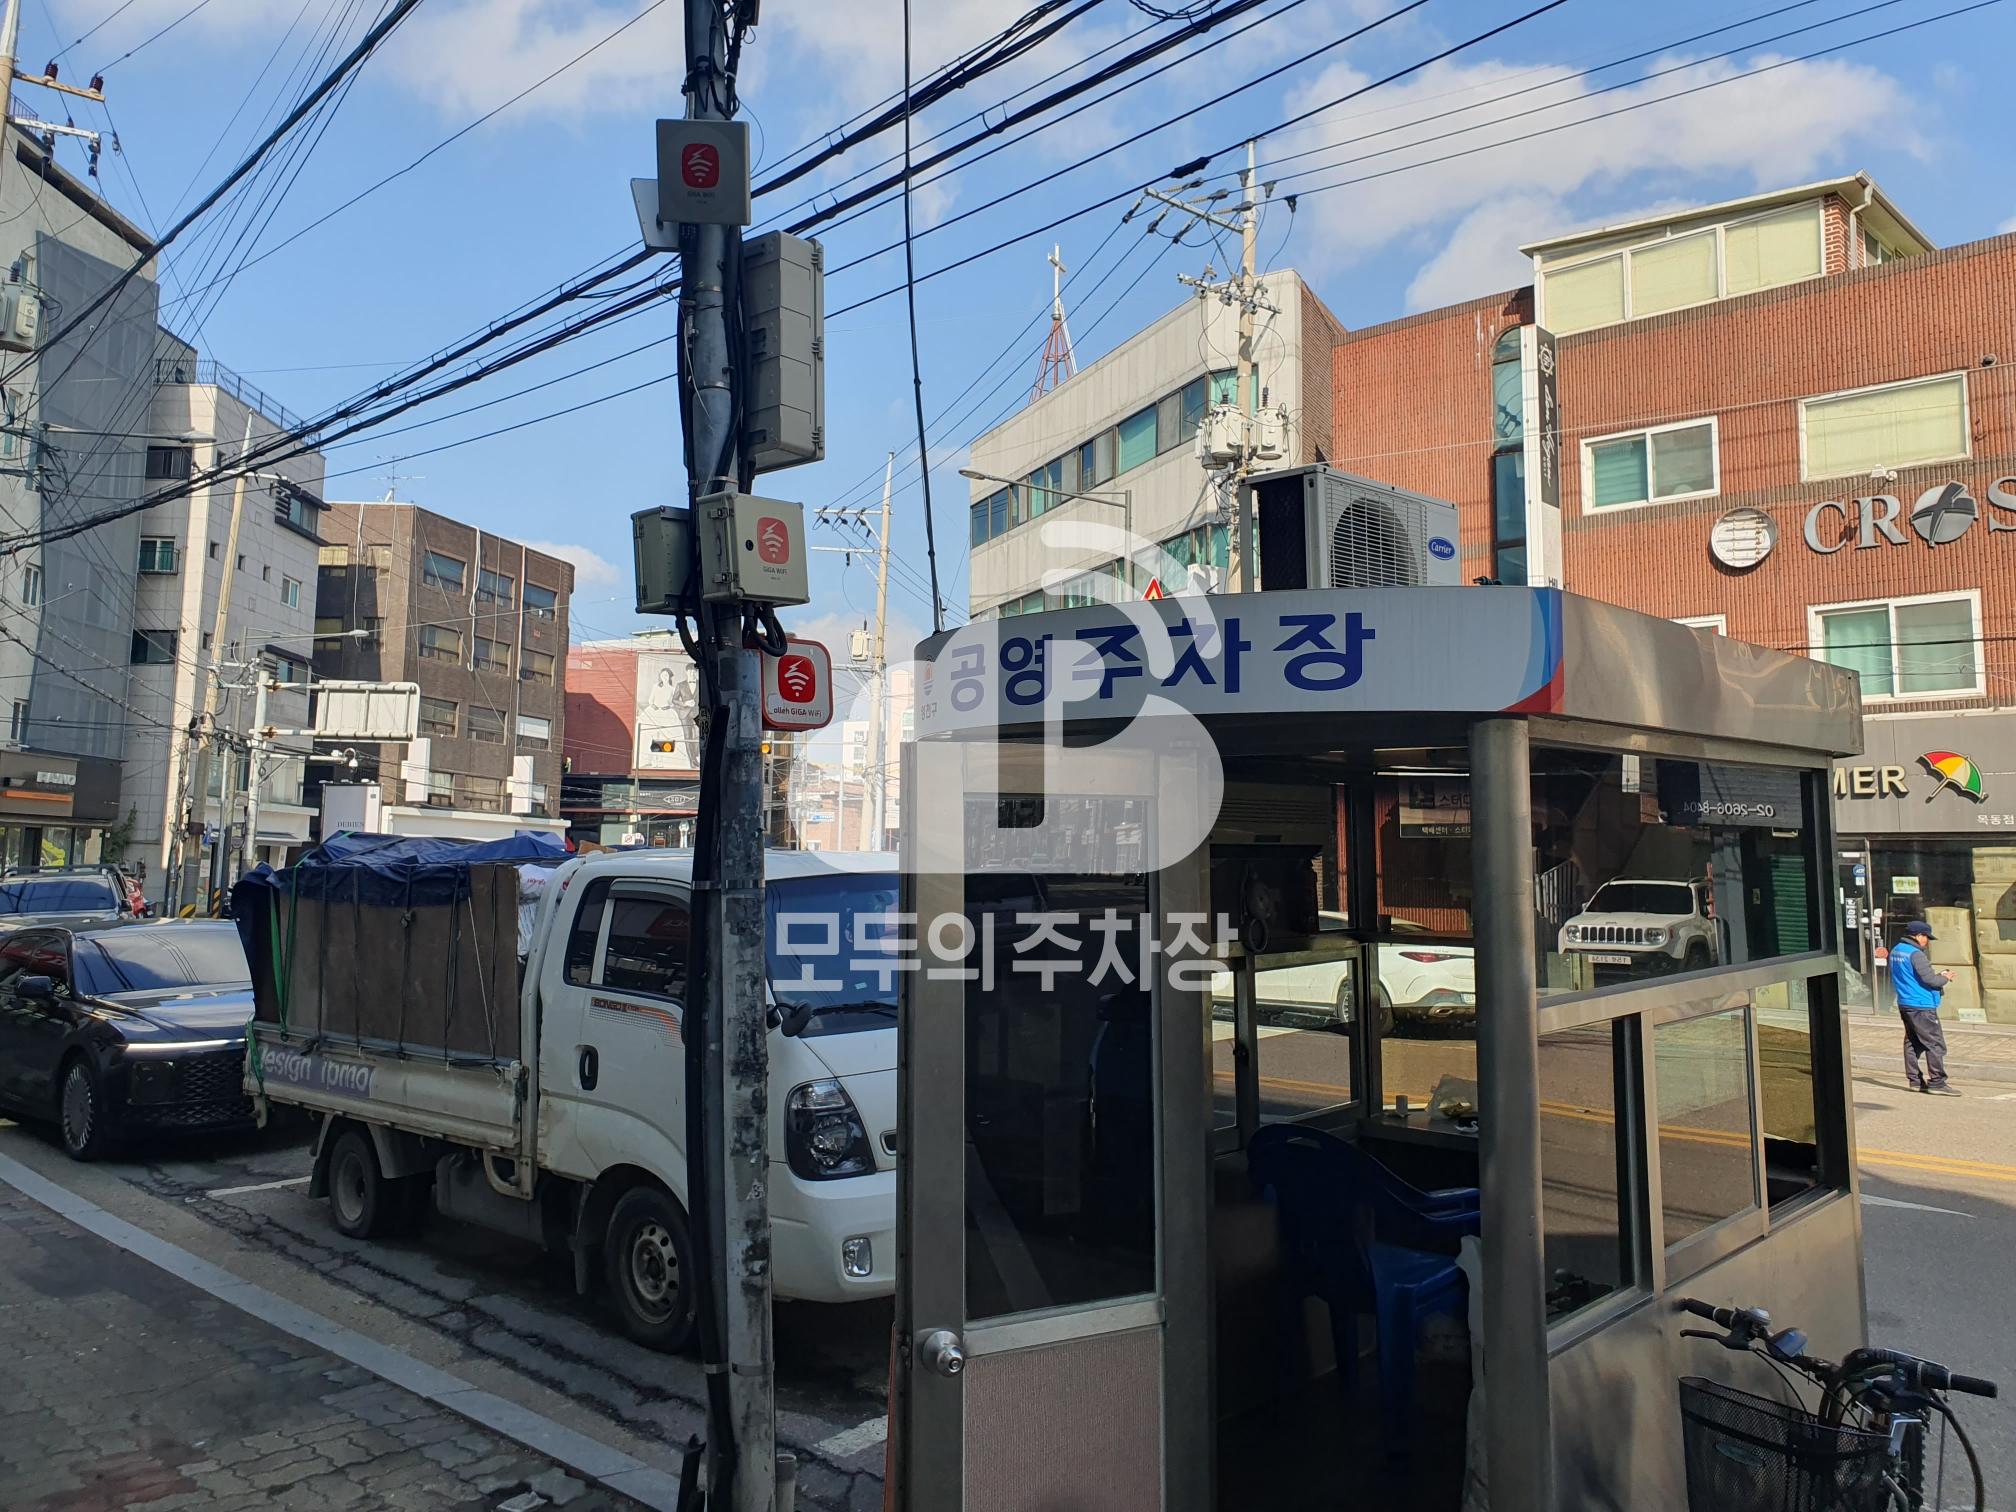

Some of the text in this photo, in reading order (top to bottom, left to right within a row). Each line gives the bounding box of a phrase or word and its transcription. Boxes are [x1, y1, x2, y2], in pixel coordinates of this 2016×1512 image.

[1431, 541, 1452, 554] Carrier
[950, 612, 1376, 713] 공영주차장
[773, 706, 790, 715] olleh
